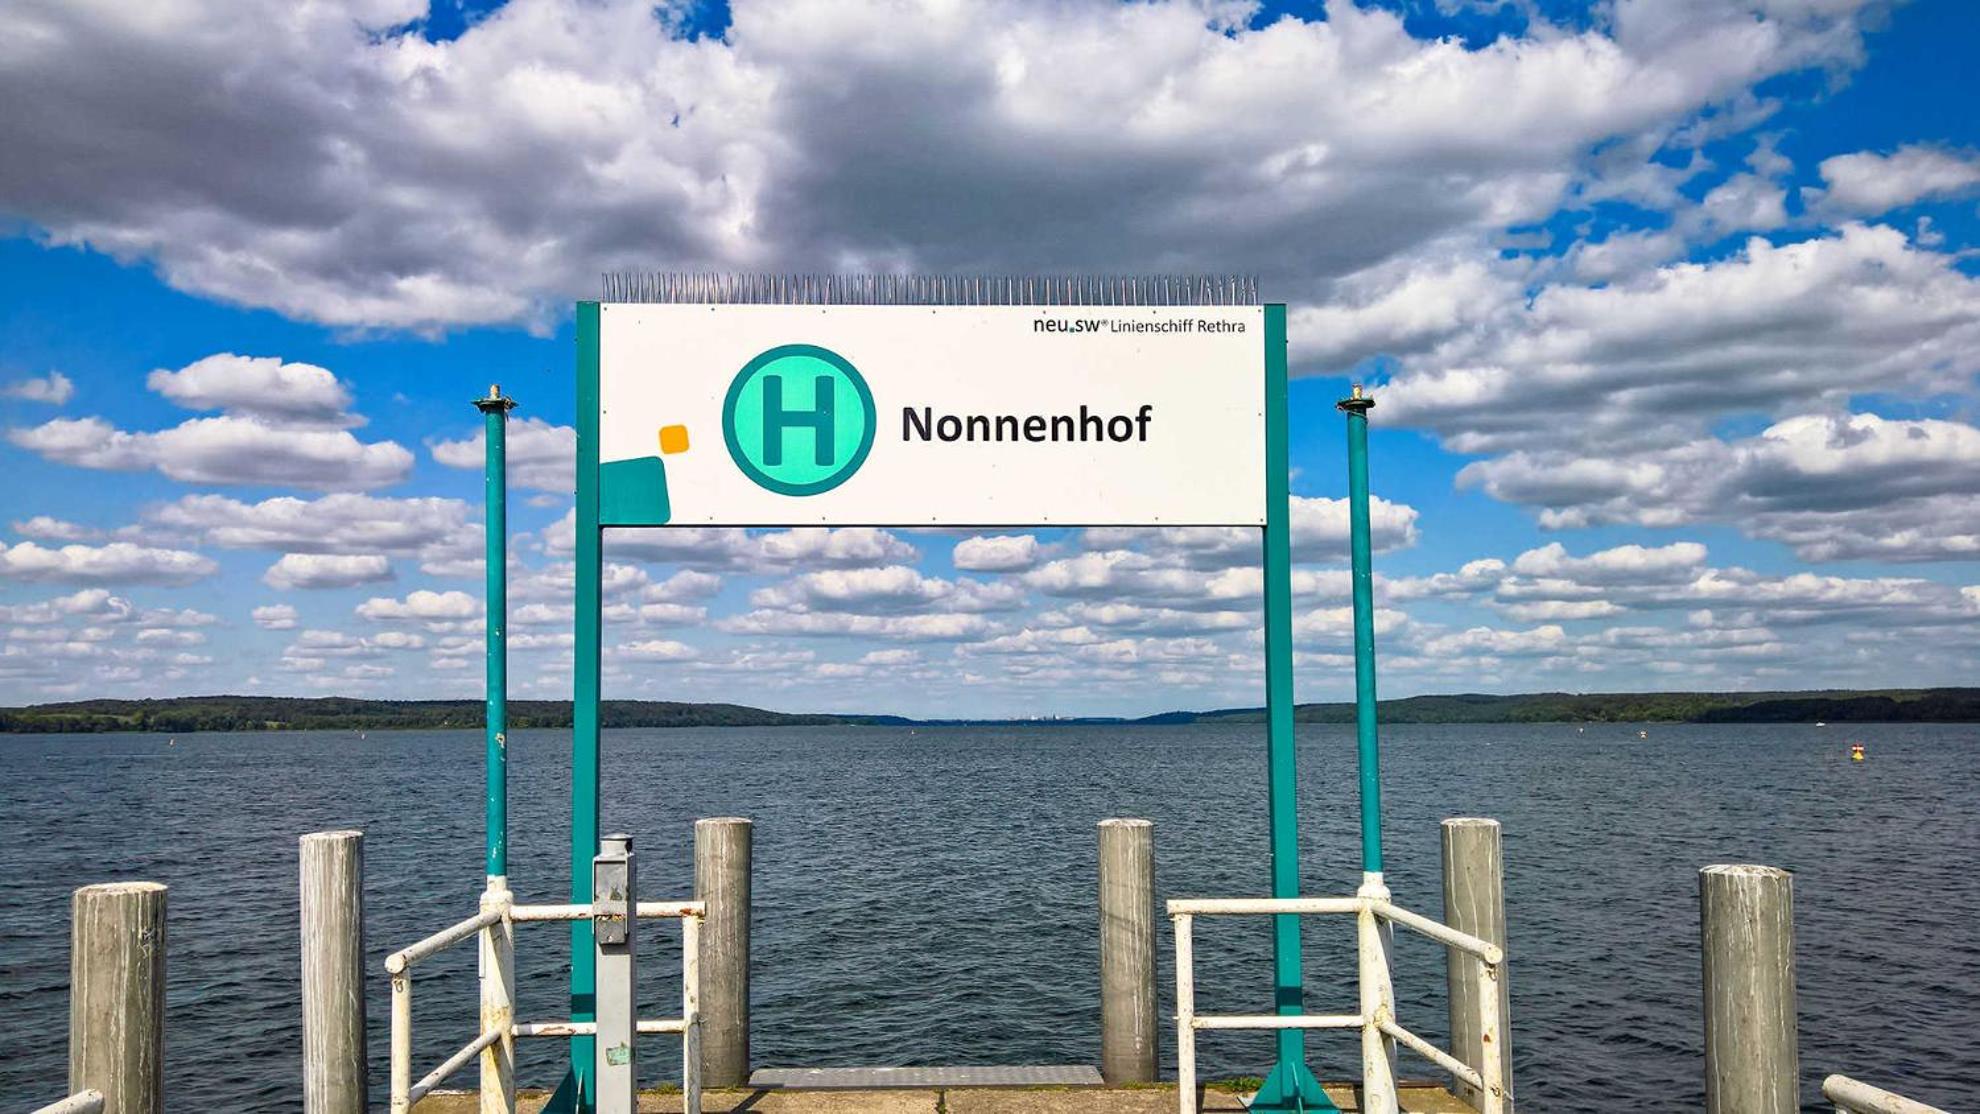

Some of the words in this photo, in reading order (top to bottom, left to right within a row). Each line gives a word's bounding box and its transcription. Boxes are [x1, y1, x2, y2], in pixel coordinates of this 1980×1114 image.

[1111, 319, 1193, 333] Linienschiff
[1198, 320, 1246, 333] Rethra
[762, 375, 835, 467] H
[902, 405, 1153, 443] Nonnenhof
